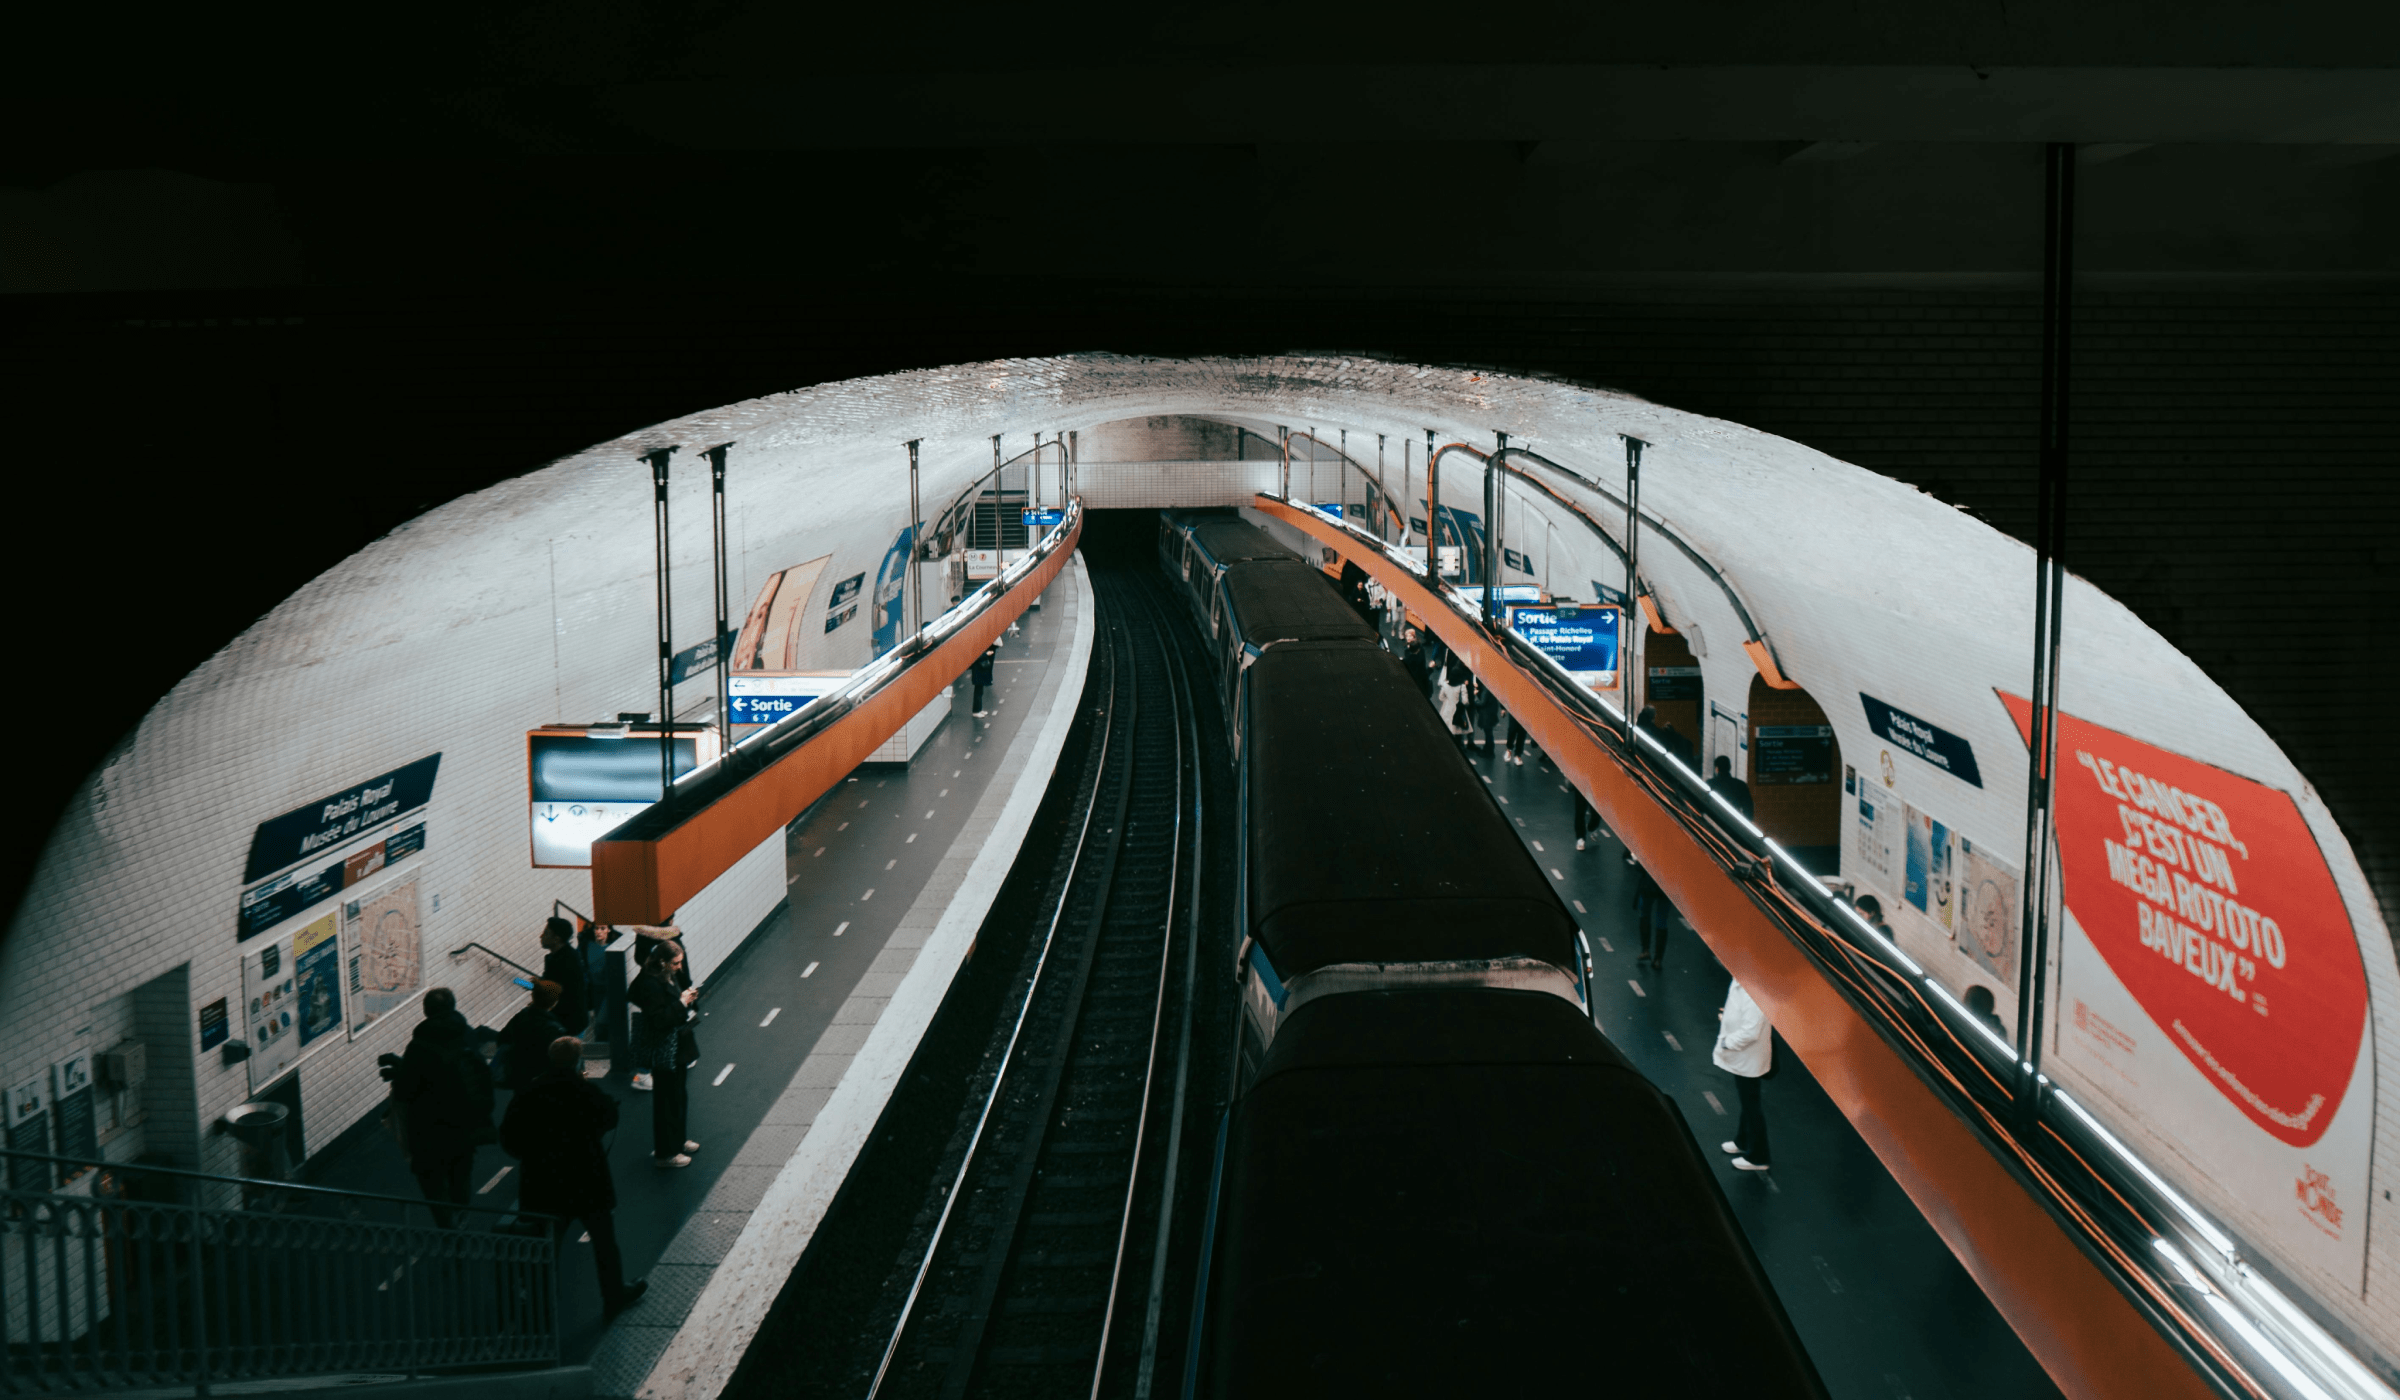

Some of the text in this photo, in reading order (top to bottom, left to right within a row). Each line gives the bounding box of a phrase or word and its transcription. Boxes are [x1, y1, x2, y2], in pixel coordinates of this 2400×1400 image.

[1518, 612, 1557, 625] Sortie
[1573, 636, 1594, 644] Royal
[751, 698, 793, 712] Sortie
[752, 713, 770, 722] 6 7
[1759, 739, 1784, 748] Sortie
[321, 778, 395, 823] Palais Royal
[2118, 765, 2249, 860] CANCER,
[299, 823, 342, 854] Musée
[343, 816, 360, 835] du
[361, 800, 399, 827] Louvre
[2186, 835, 2238, 895] UN
[2172, 871, 2287, 970] ROTOTO
